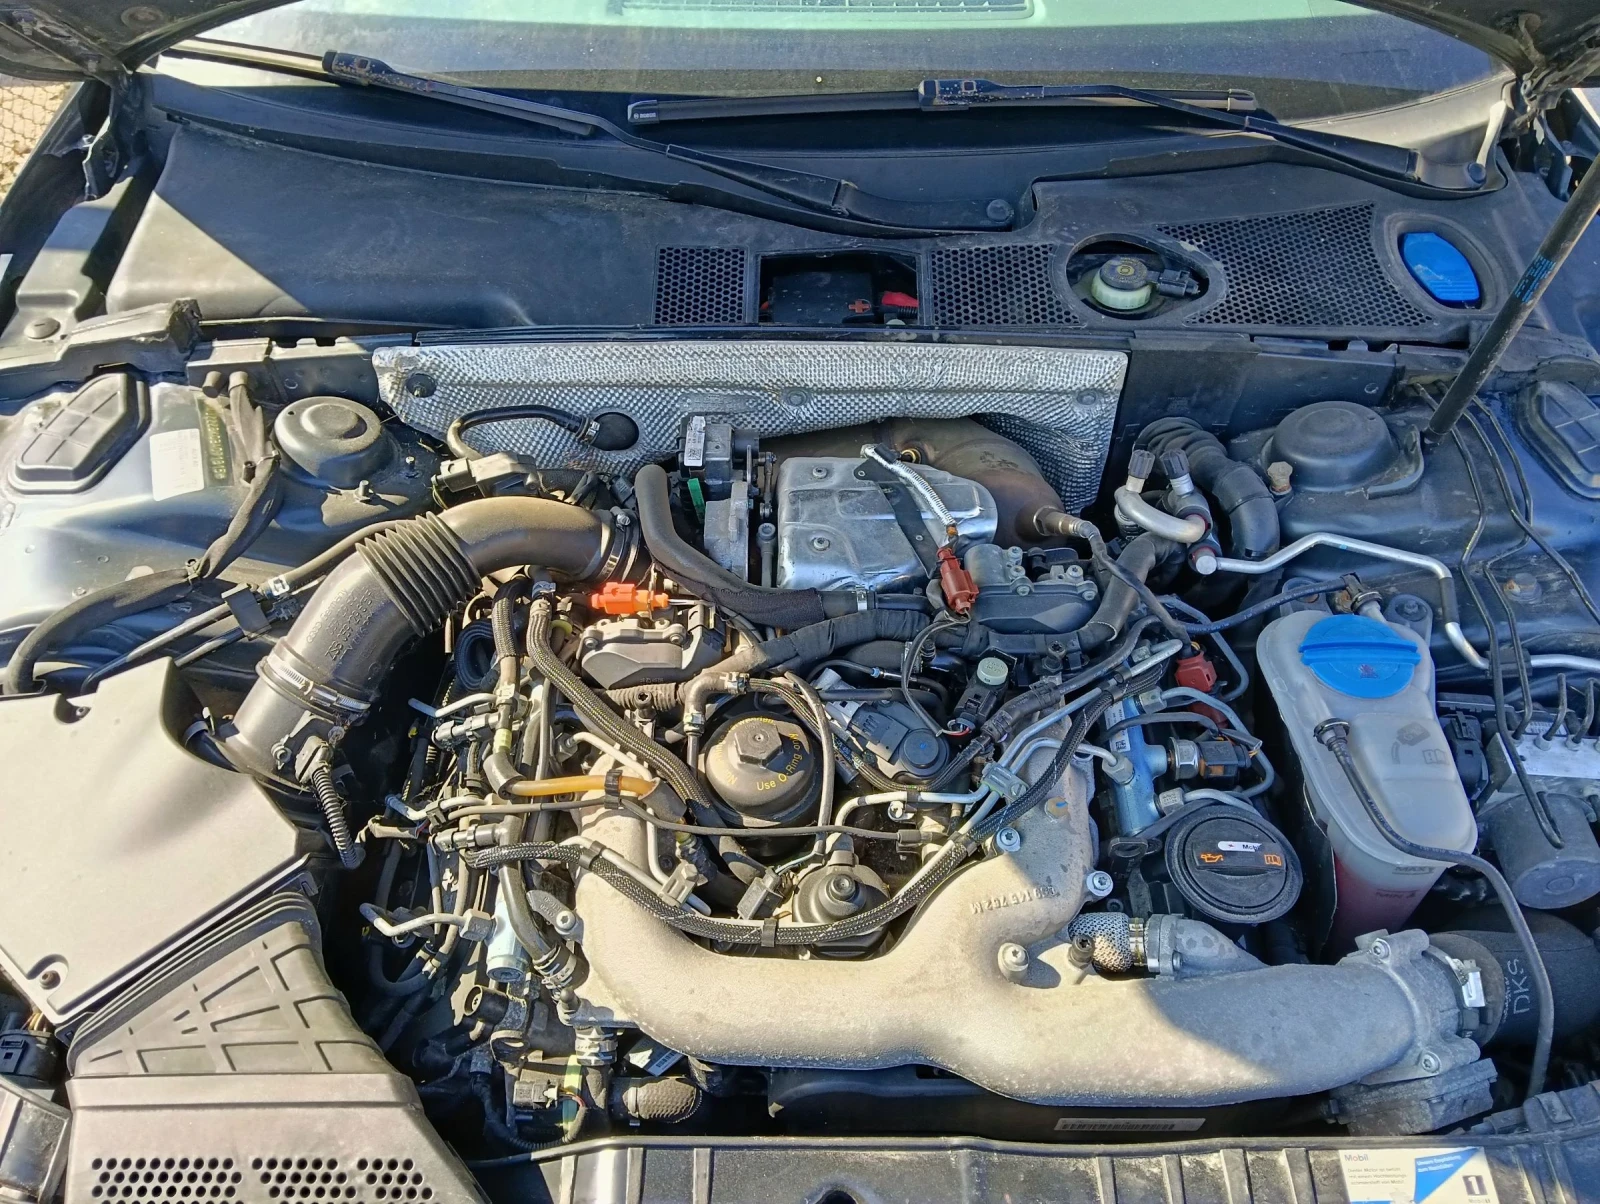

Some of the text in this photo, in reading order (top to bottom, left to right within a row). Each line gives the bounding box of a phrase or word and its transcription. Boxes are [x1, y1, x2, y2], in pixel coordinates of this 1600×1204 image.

[324, 641, 344, 660] ZSB
[757, 733, 803, 791] Use O-Ring only
[1344, 1154, 1369, 1162] Mobil
